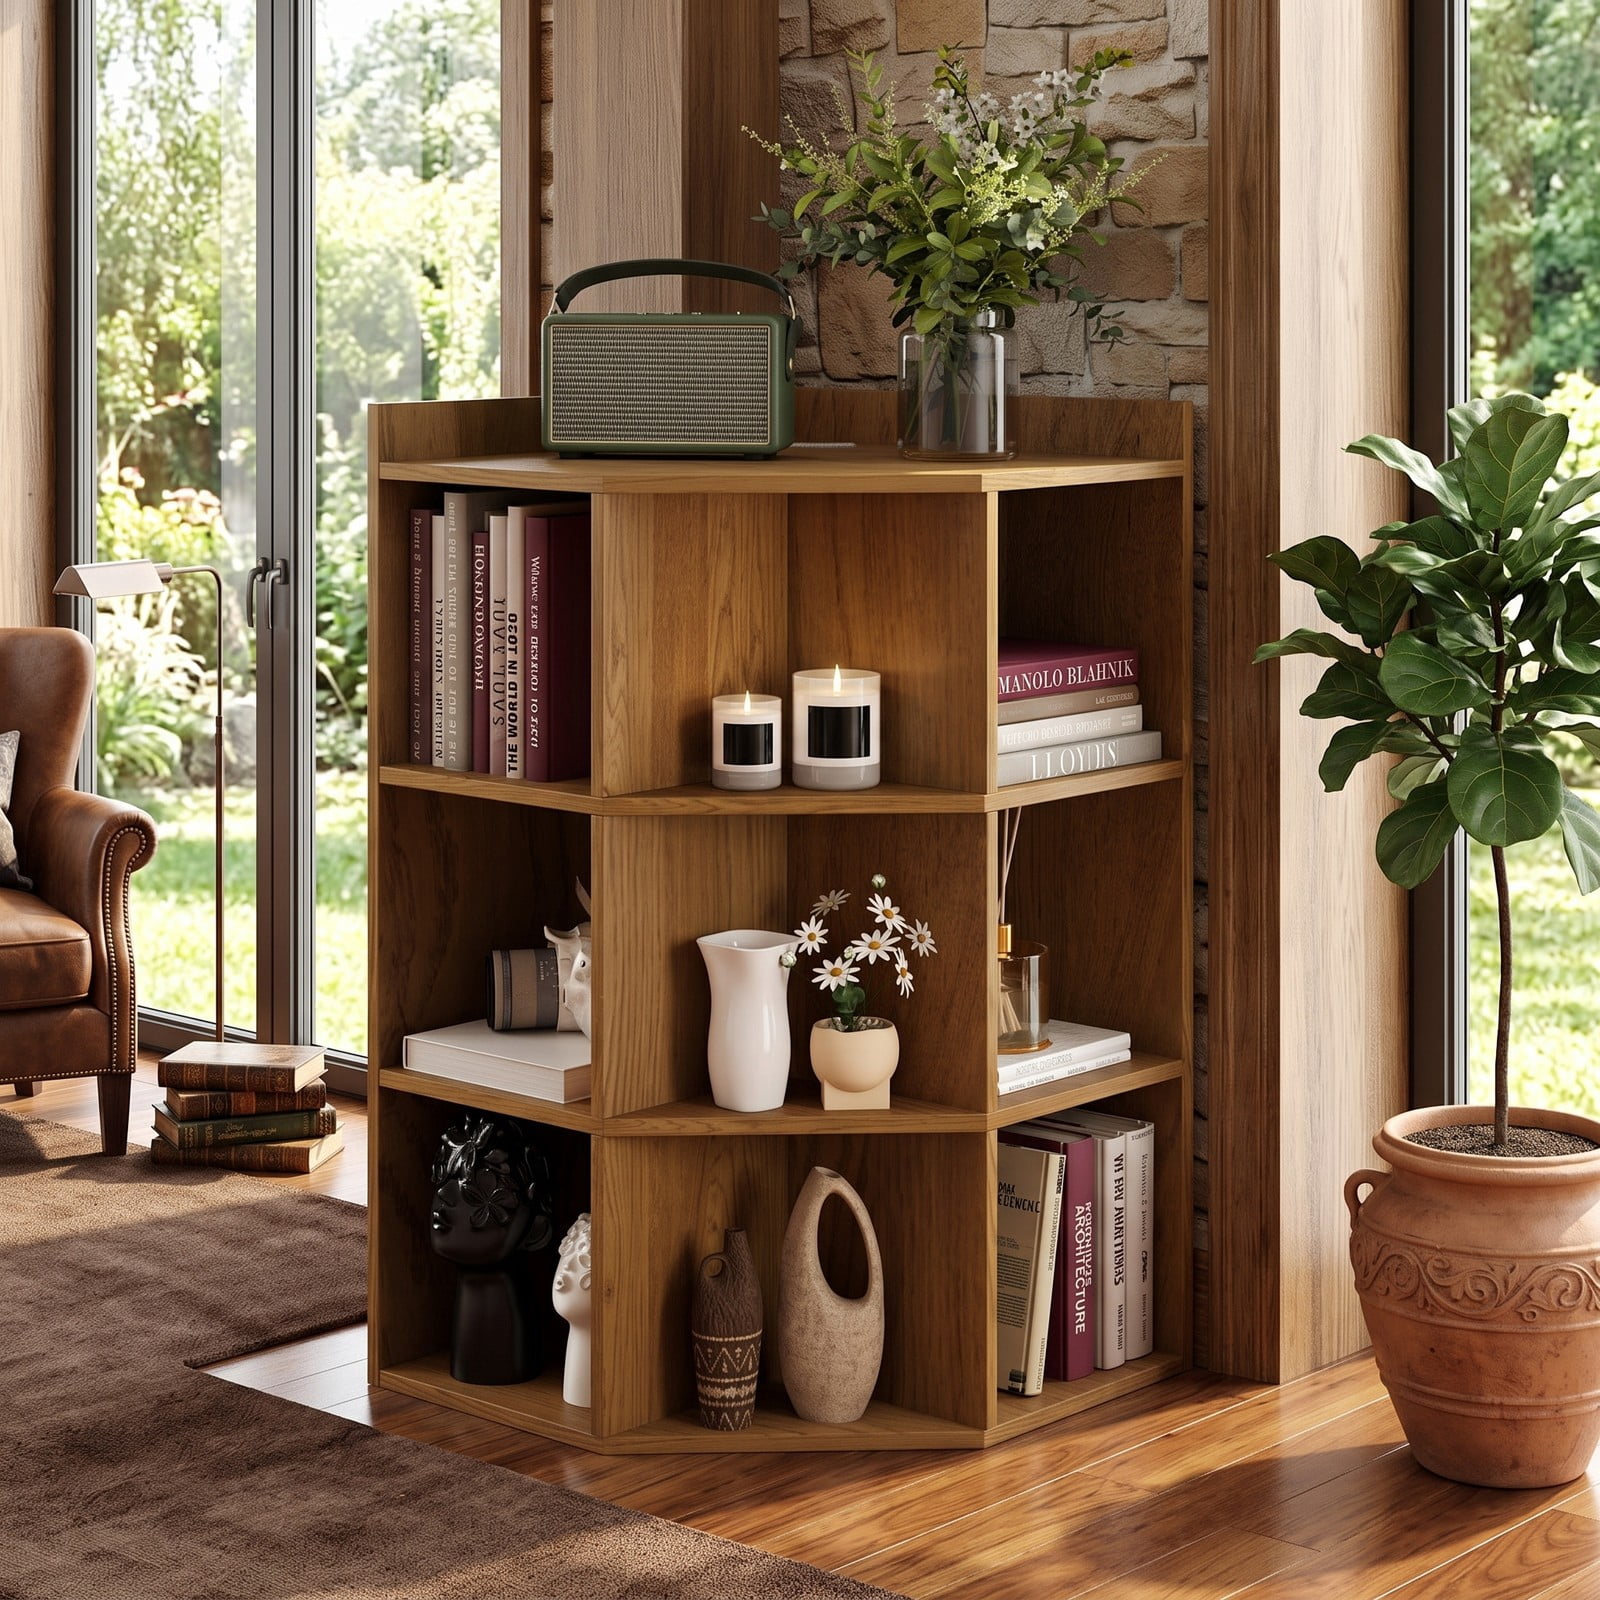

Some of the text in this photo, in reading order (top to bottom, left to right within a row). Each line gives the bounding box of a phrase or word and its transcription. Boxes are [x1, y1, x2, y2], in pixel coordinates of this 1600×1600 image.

[508, 660, 518, 675] IN
[998, 659, 1134, 695] MANOLO BLAHNIK
[508, 681, 518, 738] WORLD
[508, 744, 518, 773] THE
